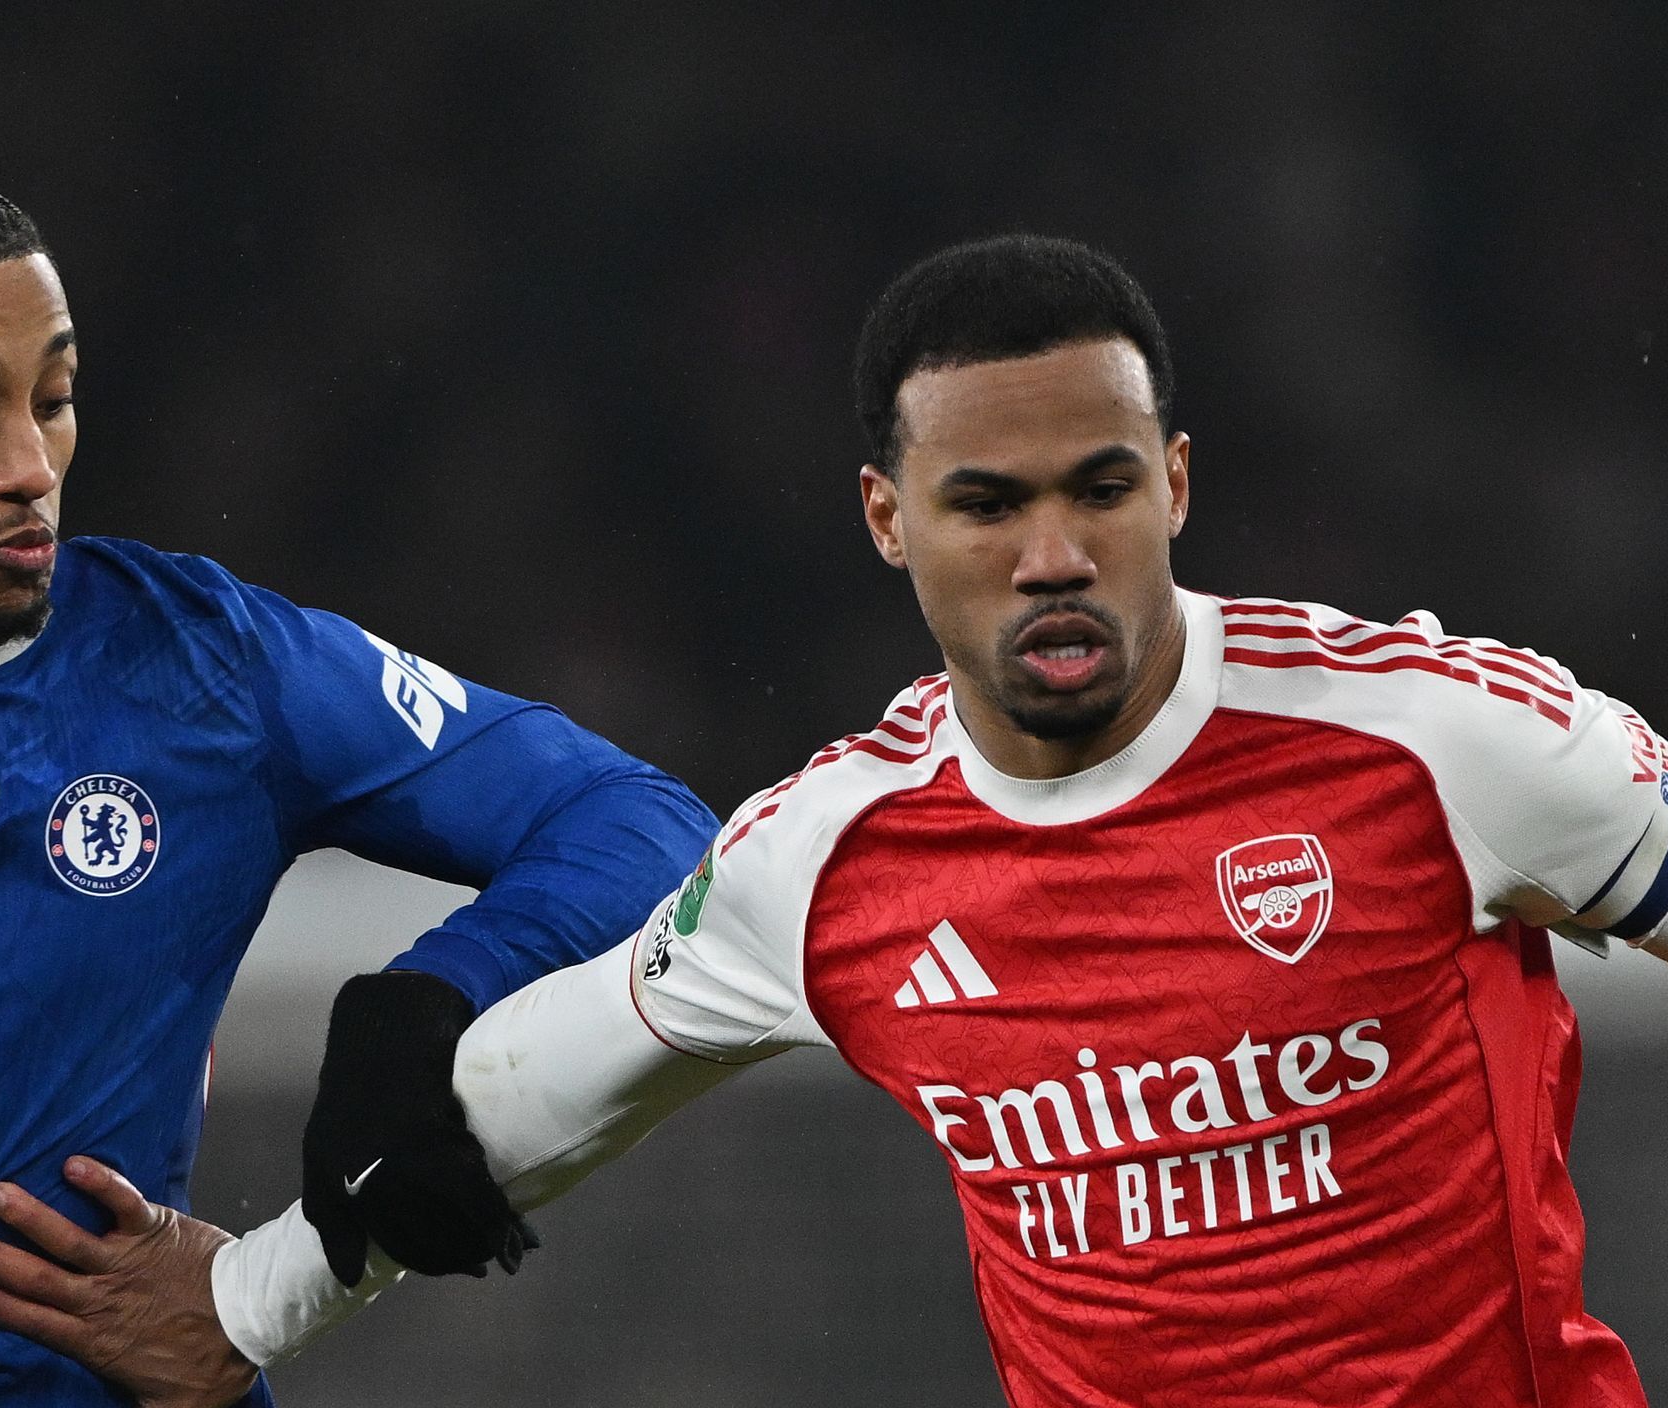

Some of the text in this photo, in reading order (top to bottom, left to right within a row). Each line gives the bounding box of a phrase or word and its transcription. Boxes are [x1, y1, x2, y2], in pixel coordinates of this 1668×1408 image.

[65, 779, 138, 805] CHELSEA
[66, 865, 143, 889] FOOTBALL CLUB
[1233, 851, 1313, 886] Arsenal
[915, 1017, 1390, 1173] Emirates
[1012, 1122, 1343, 1259] FLY BETTER
